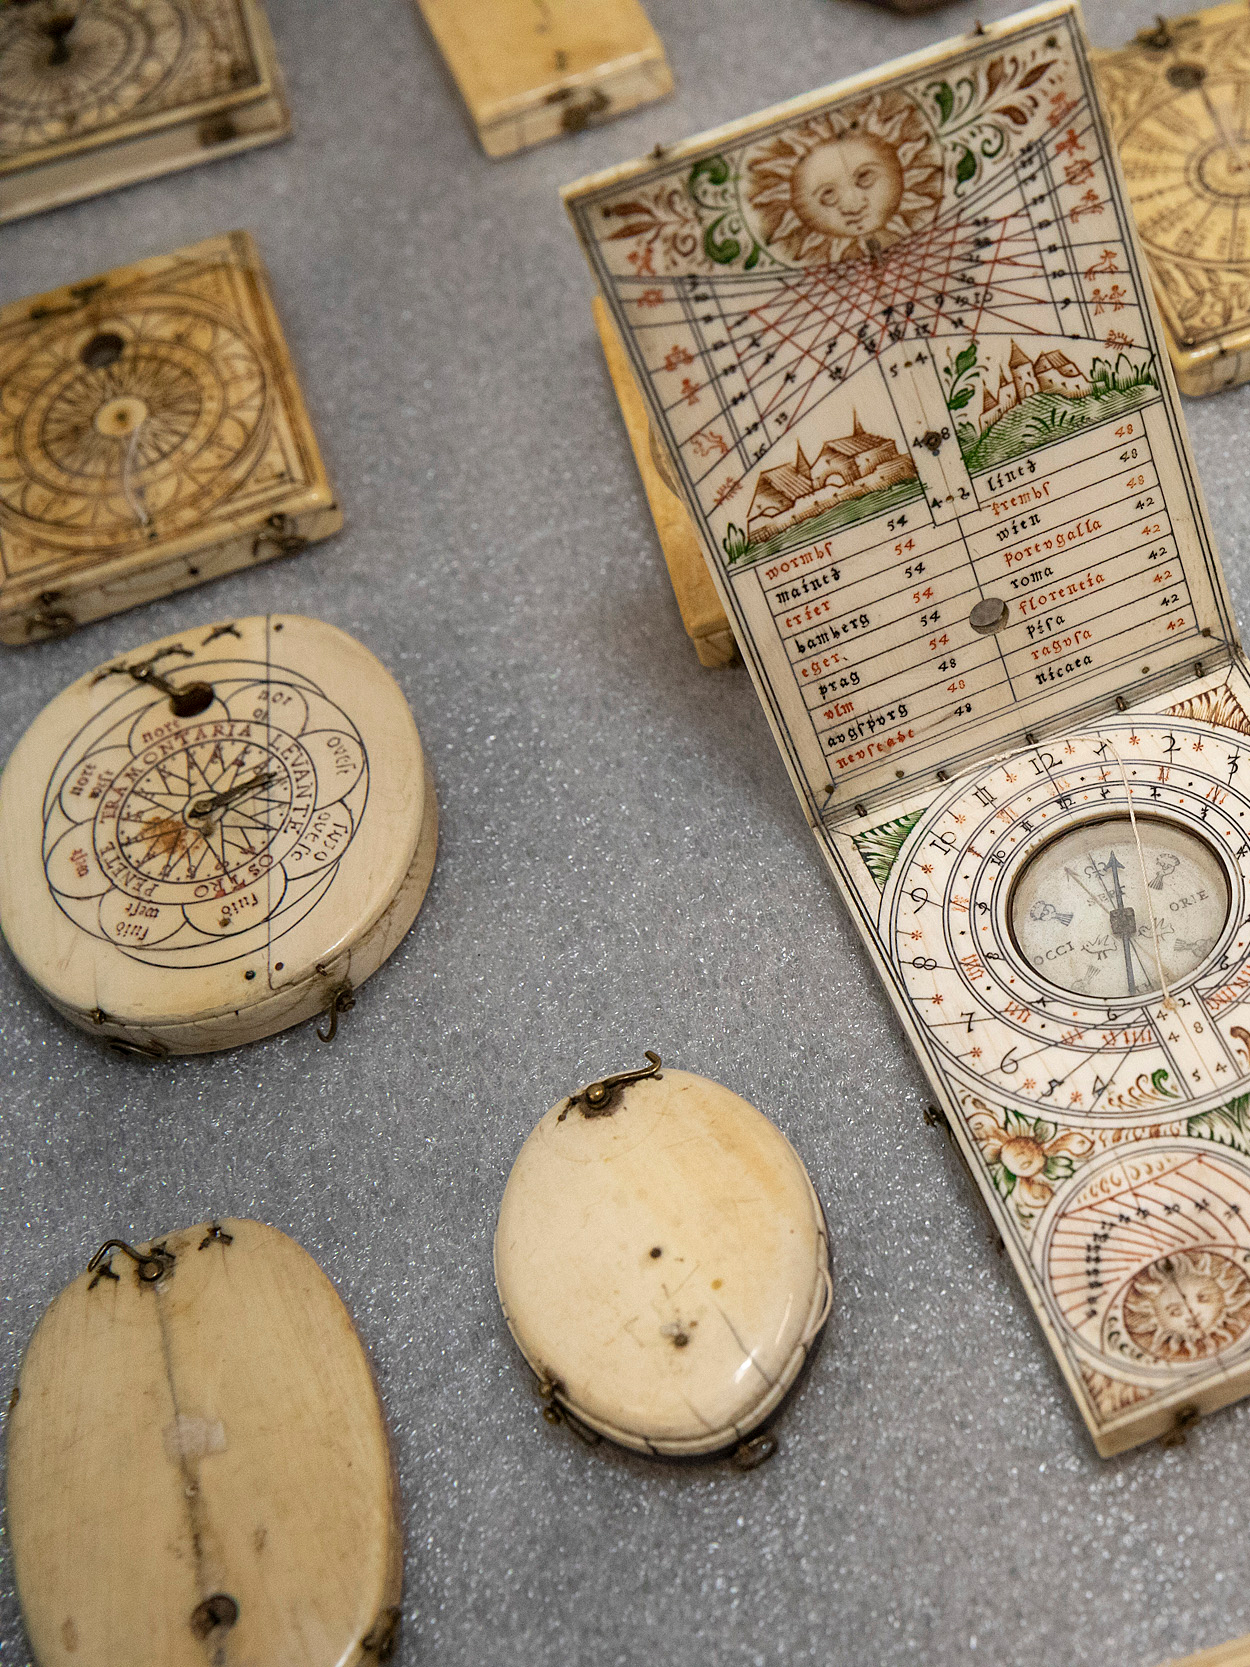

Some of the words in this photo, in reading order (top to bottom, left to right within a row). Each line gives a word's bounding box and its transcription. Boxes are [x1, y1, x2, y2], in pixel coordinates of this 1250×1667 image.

[1114, 423, 1134, 438] 48
[1119, 448, 1138, 462] 48
[996, 513, 1042, 542] wien
[1126, 474, 1145, 489] 48
[1135, 497, 1155, 510] 42
[887, 515, 909, 532] 54
[894, 539, 916, 556] 54
[1010, 565, 1055, 590] roma
[1141, 524, 1161, 536] 42
[905, 562, 926, 578] 54
[1153, 570, 1173, 583] 42
[1018, 572, 1105, 616] florentia
[1148, 547, 1168, 560] 42
[1160, 594, 1180, 607] 42
[794, 613, 870, 653] bamberg
[913, 587, 934, 604] 54
[1166, 617, 1186, 631] 42
[801, 653, 840, 678] eger
[920, 610, 941, 627] 54
[819, 671, 861, 700] prag
[929, 634, 950, 650] 54
[938, 659, 957, 672] 48
[947, 679, 966, 693] 48
[954, 703, 973, 717] 48
[1161, 735, 1181, 754] 2
[910, 887, 929, 914] 9
[912, 956, 937, 971] 8
[999, 1046, 1019, 1074] 6
